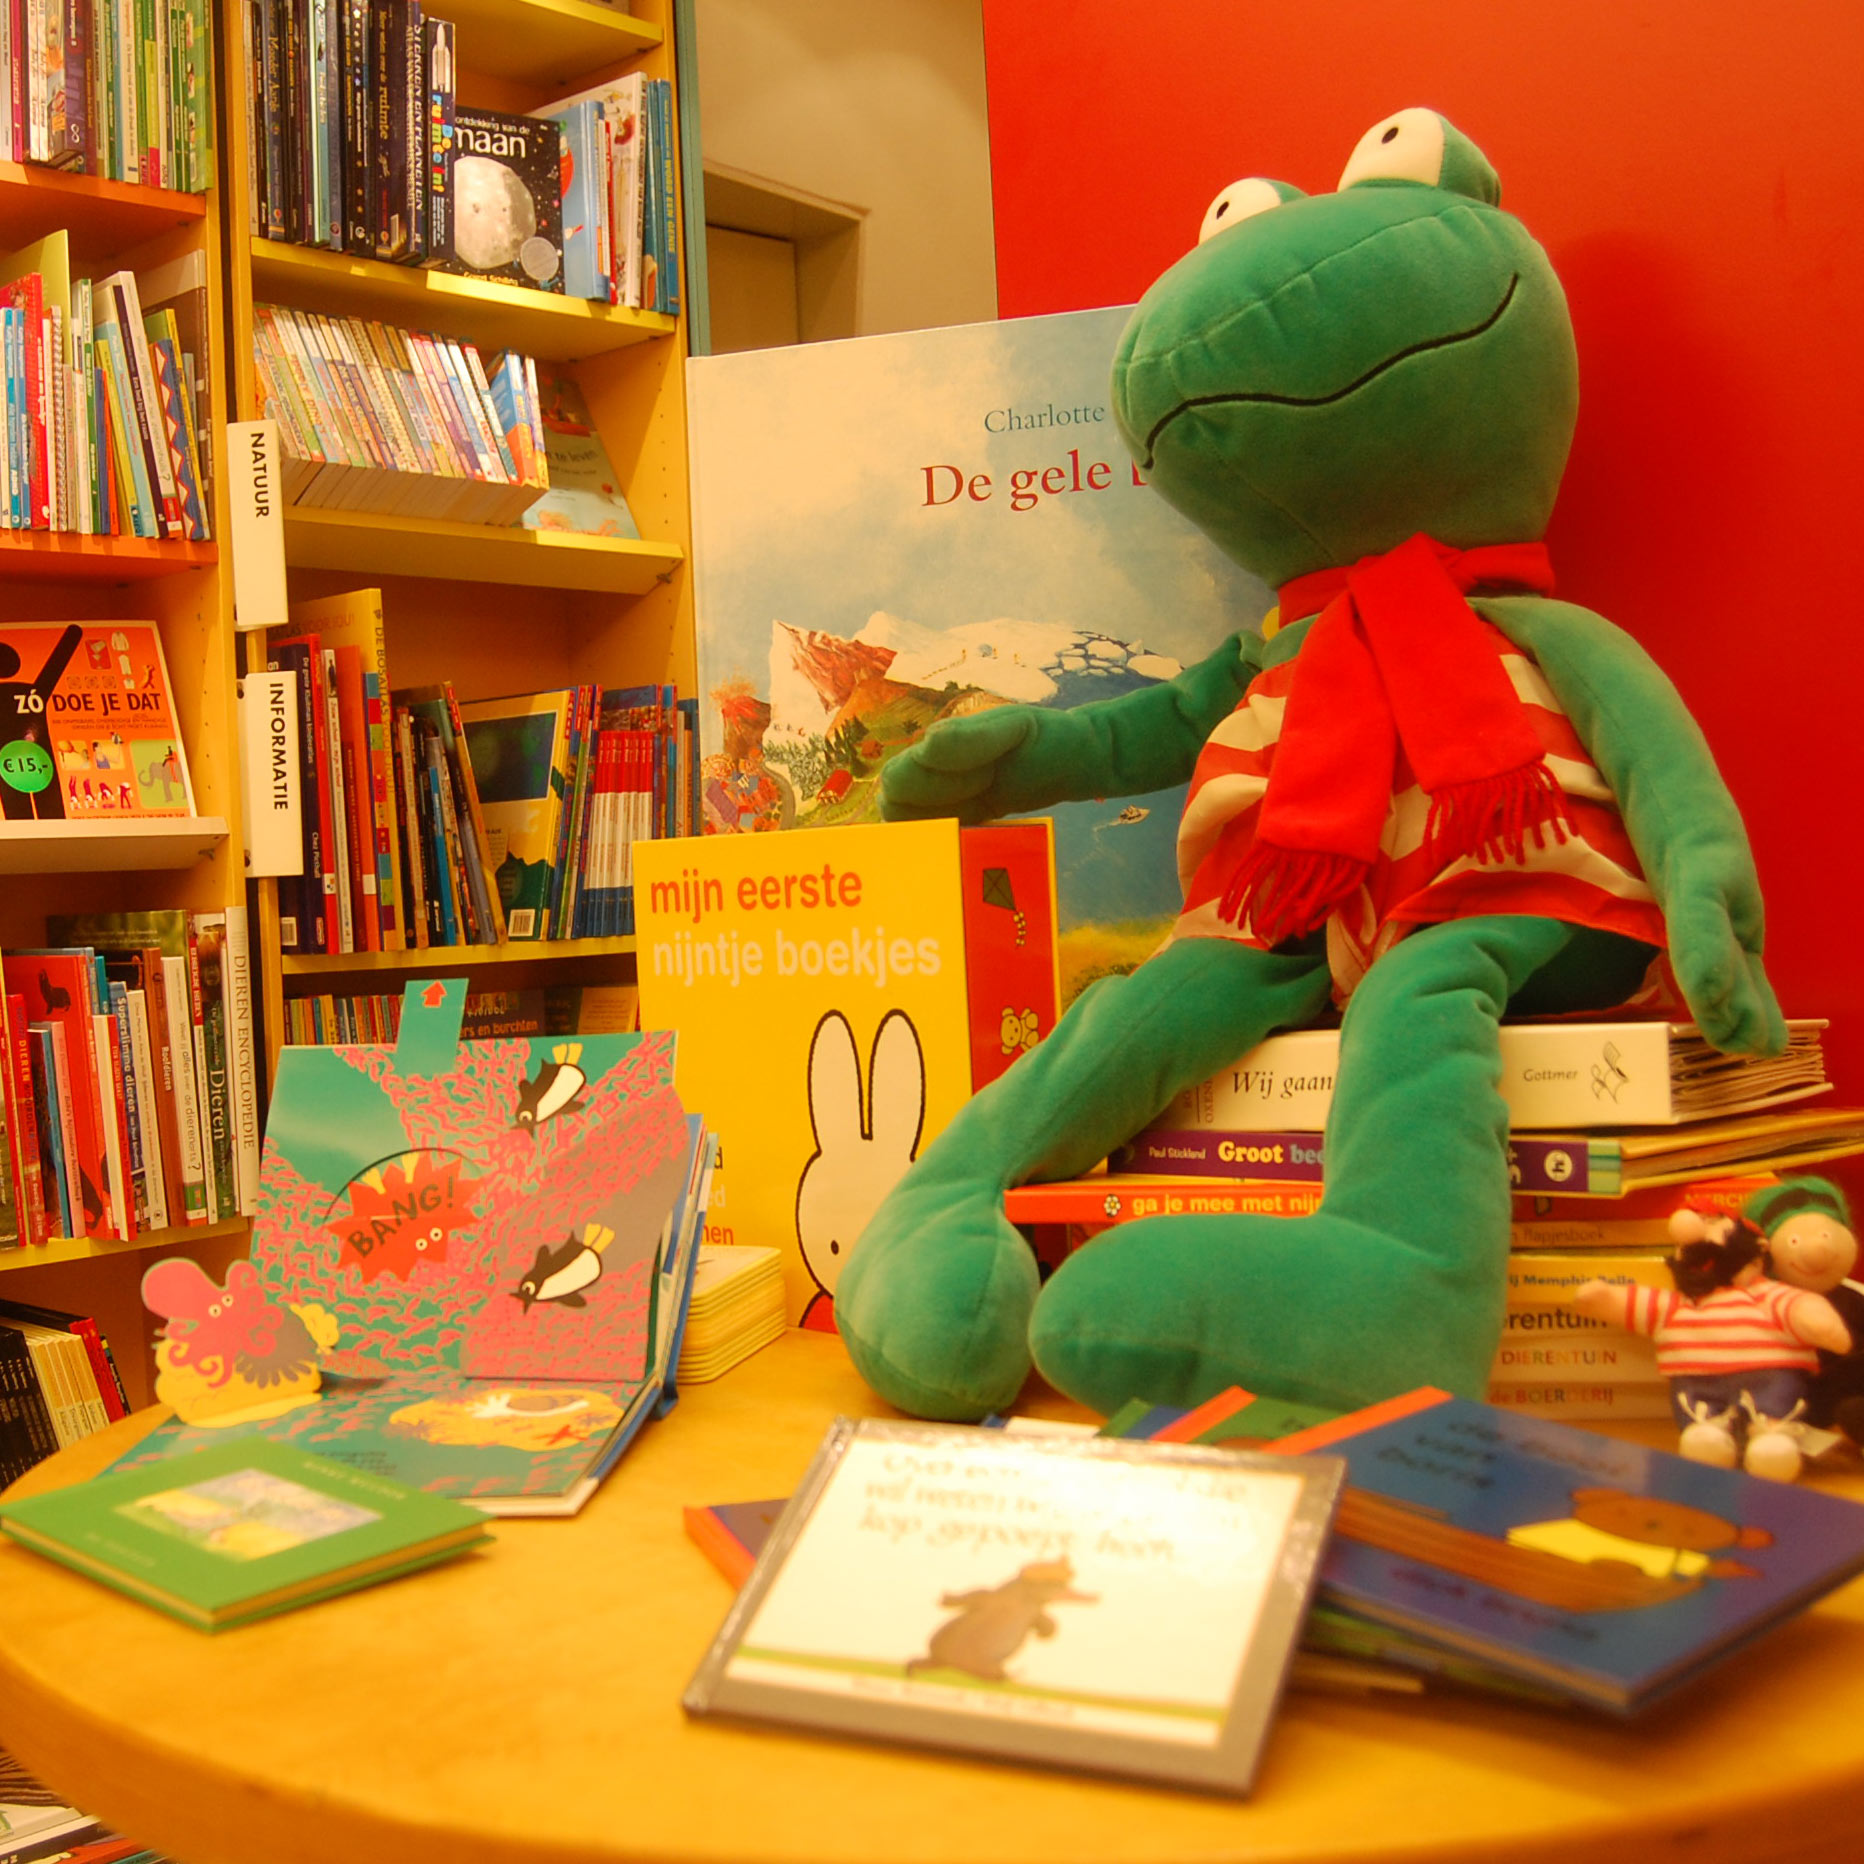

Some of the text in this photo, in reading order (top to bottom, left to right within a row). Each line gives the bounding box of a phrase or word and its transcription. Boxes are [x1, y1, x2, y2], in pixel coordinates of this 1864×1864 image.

[378, 84, 390, 140] ruimte
[413, 97, 423, 123] EN
[430, 93, 446, 164] ruimte
[984, 403, 1105, 433] Charlotte
[250, 431, 270, 518] NATUUR
[920, 448, 1112, 512] De gele
[373, 625, 384, 642] DE
[13, 689, 161, 717] ZÓ DOE JE DAT
[269, 682, 289, 810] INFORMATIE
[650, 863, 863, 924] mijn eerste
[653, 926, 943, 989] nijntje boekjes
[19, 1040, 29, 1081] DIEREN
[117, 996, 131, 1069] Superslimme
[124, 1072, 136, 1112] dieren
[161, 1046, 172, 1091] Roofdieren
[180, 1048, 191, 1072] alles
[232, 953, 256, 1149] DIEREN ENCYCLOPEDIE
[1232, 1071, 1333, 1100] Wij gaan
[1522, 1069, 1578, 1082] Gottmer
[183, 1091, 193, 1105] de
[209, 1068, 226, 1141] Dieren
[1149, 1146, 1166, 1159] Paul
[1168, 1147, 1206, 1160] Stickland
[1217, 1141, 1284, 1164] Groot
[347, 1175, 454, 1259] BANG!
[1132, 1195, 1158, 1214] ga
[1164, 1193, 1183, 1215] je
[1190, 1196, 1235, 1212] mee
[1242, 1194, 1282, 1212] met
[1501, 1351, 1617, 1365] DIERENTUIN
